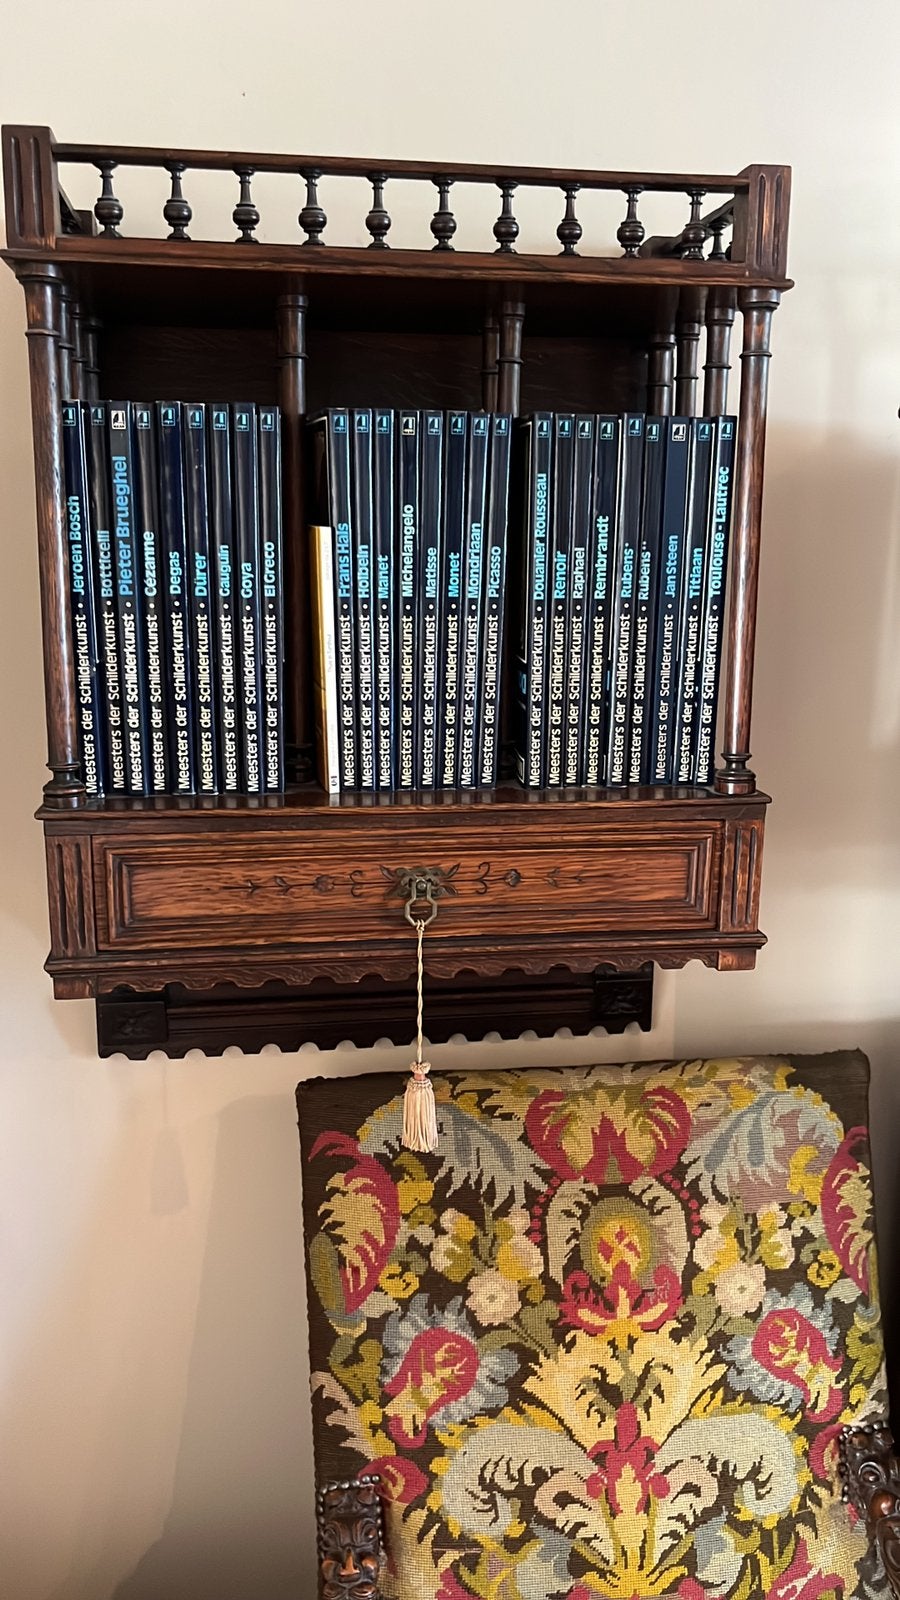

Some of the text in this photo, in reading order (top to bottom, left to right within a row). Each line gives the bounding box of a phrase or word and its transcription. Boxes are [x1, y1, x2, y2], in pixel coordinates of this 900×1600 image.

[67, 496, 96, 793] Meesters der Schilderkunst Jeroen Bosch
[97, 530, 124, 789] Meesters der Schilderkunst Botticelli
[112, 456, 143, 791] Meesters der Schilderkunst Pieter Brueghel
[144, 532, 165, 791] Meesters der Schilderkunst Cézanne
[169, 552, 190, 789] Meesters der Schilderkunst Degas
[195, 553, 213, 790] Meesters der Schilderkunst Dürer
[219, 545, 237, 790] Meesters der Schilderkunst Gauguin
[241, 563, 259, 792] Meesters der Schilderkunst Goya
[264, 542, 274, 583] Greco
[265, 615, 277, 701] Schilderkunst
[337, 523, 355, 786] Meesters der Schilderkunst Frans Hals
[357, 545, 373, 786] Meesters der Schilderkunst Holbein
[378, 555, 390, 786] Meesters der Schilderkunst Manet
[401, 504, 414, 786] Meesters der Schilderkunst Michelangelo
[423, 547, 437, 785] Meesters der Schilderkunst Matisse
[443, 553, 460, 785] Meesters der Schilderkunst Monet
[461, 523, 481, 785] Meesters der Schilderkunst Mondriaan
[482, 546, 501, 783] Meesters der Schilderkunst Picasso
[530, 473, 547, 786] Meesters der Schilderkunst Douanier Rousseau
[549, 551, 567, 784] Meesters der Schilderkunst Renoir
[566, 547, 585, 783] Meesters der Schilderkunst Raphael
[588, 516, 609, 783] Meesters der Schilderkunst Rembrandt
[616, 614, 630, 698] Schilderkunst
[634, 617, 648, 700] Schilderkunst
[660, 614, 673, 697] Schilderkunst
[678, 547, 703, 782] Meesters der Schilderkunst Titiaan
[703, 616, 719, 699] Schilderkunst
[266, 706, 278, 727] der
[267, 731, 278, 788] Meesters
[612, 727, 624, 782] Meesters
[614, 702, 626, 723] der
[630, 728, 642, 783] Meesters
[632, 703, 643, 724] der
[656, 724, 667, 779] Meesters
[658, 700, 669, 721] der
[697, 727, 711, 783] Meesters
[701, 703, 713, 724] der
